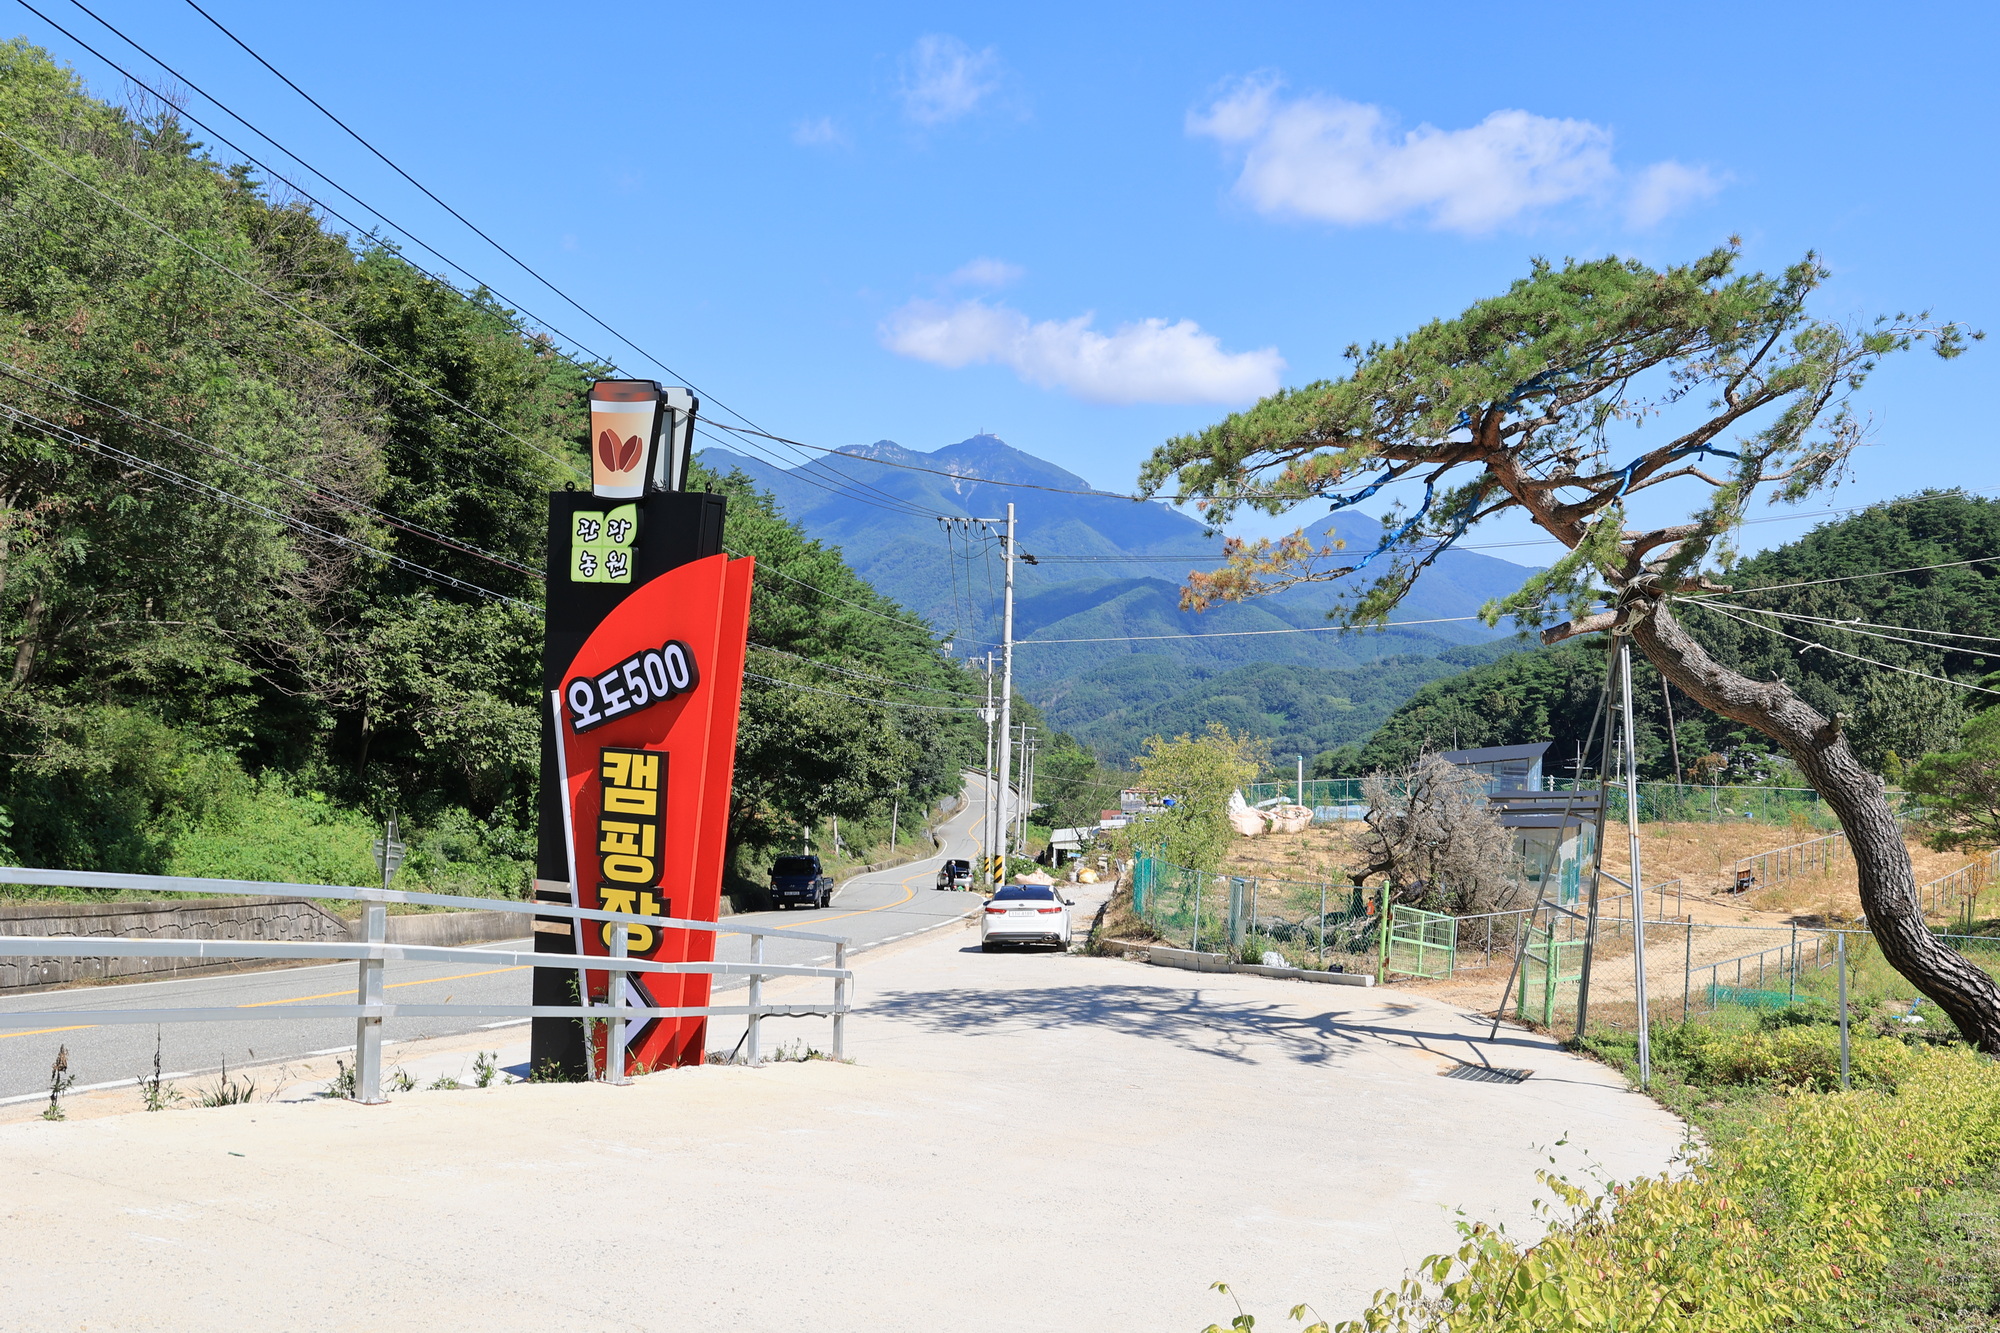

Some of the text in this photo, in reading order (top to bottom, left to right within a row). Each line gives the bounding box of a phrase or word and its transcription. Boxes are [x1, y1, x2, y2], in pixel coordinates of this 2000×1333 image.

[577, 518, 632, 543] 관광
[579, 550, 627, 578] 농원
[568, 644, 690, 730] 오도500
[600, 751, 661, 953] 캠핑장
